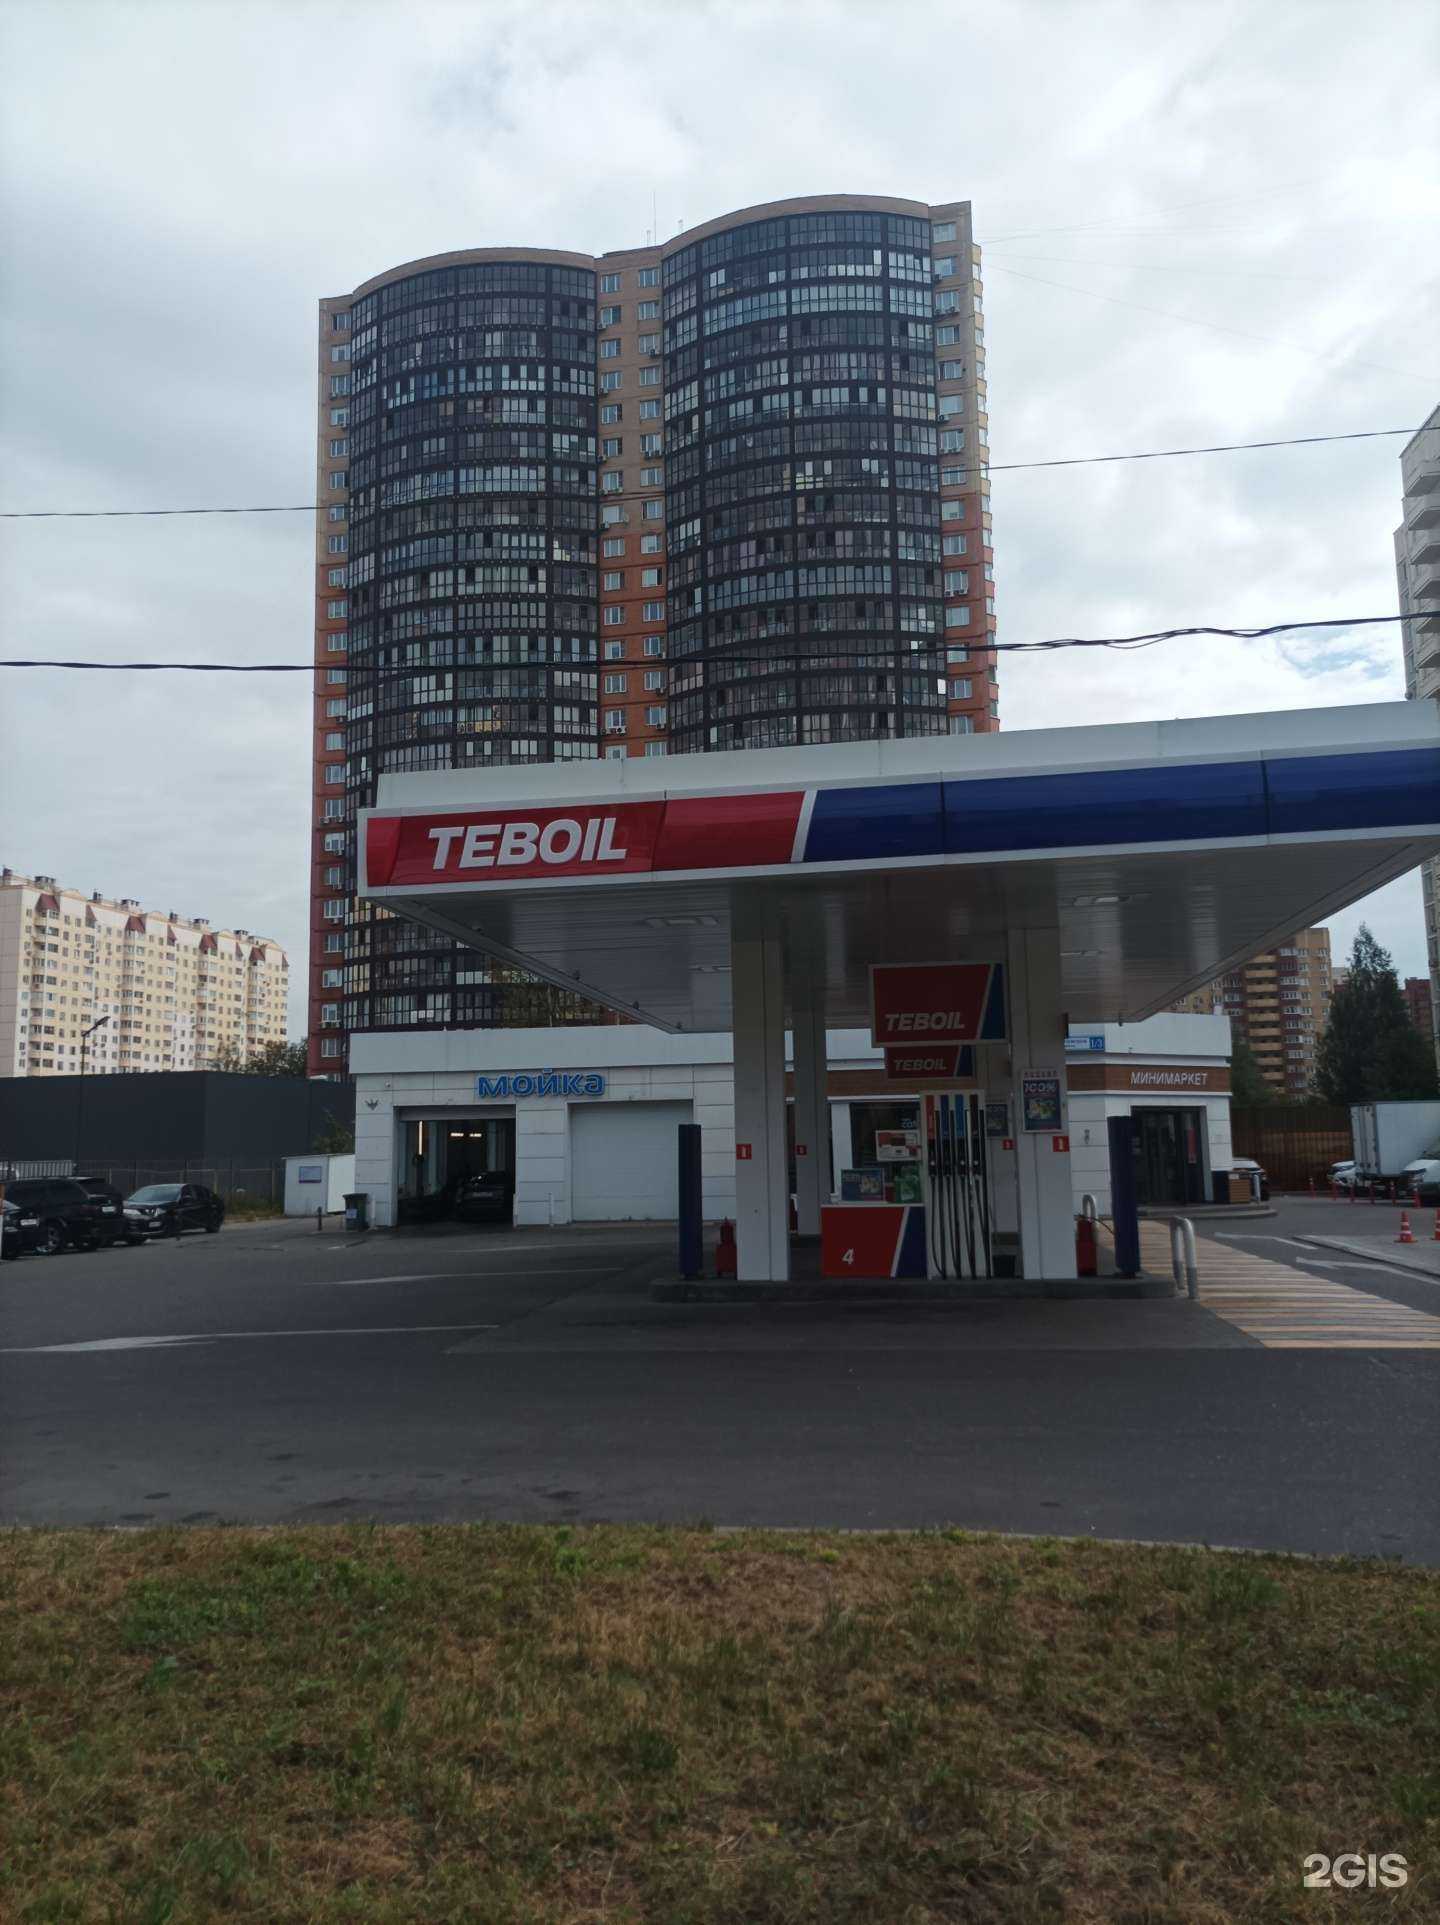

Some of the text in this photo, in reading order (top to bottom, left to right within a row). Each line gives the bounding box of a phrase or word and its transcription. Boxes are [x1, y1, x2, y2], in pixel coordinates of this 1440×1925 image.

[428, 817, 628, 870] TEBOIL
[884, 1011, 966, 1032] TEBOIL
[893, 1058, 948, 1072] TEBOIL
[1130, 1071, 1209, 1086] МИНИМАРКЕТ
[841, 1248, 855, 1265] 4
